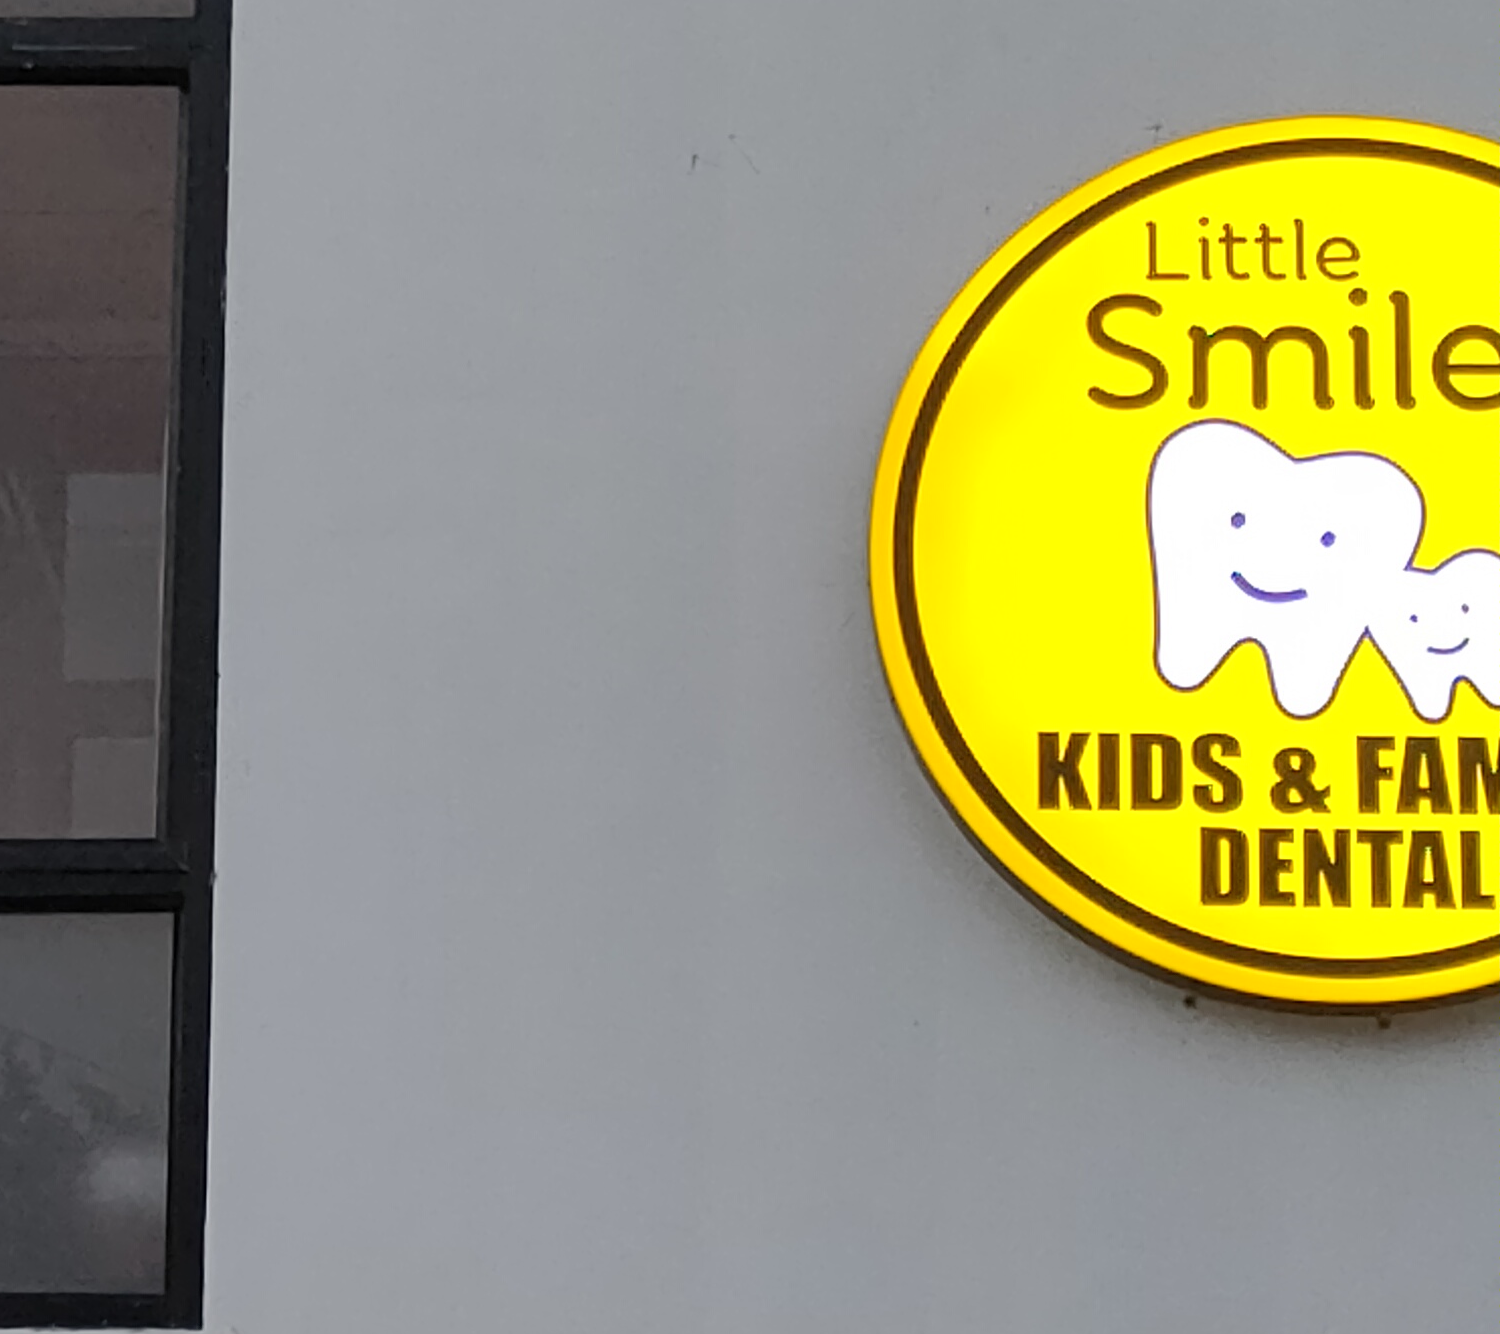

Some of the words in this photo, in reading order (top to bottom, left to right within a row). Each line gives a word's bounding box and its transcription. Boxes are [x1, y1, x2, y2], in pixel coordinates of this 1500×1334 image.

[1145, 216, 1361, 281] Little
[1086, 287, 1500, 411] Smile
[1037, 731, 1243, 813] KIDS
[1269, 747, 1331, 814] &
[1200, 826, 1496, 910] DENTAL
